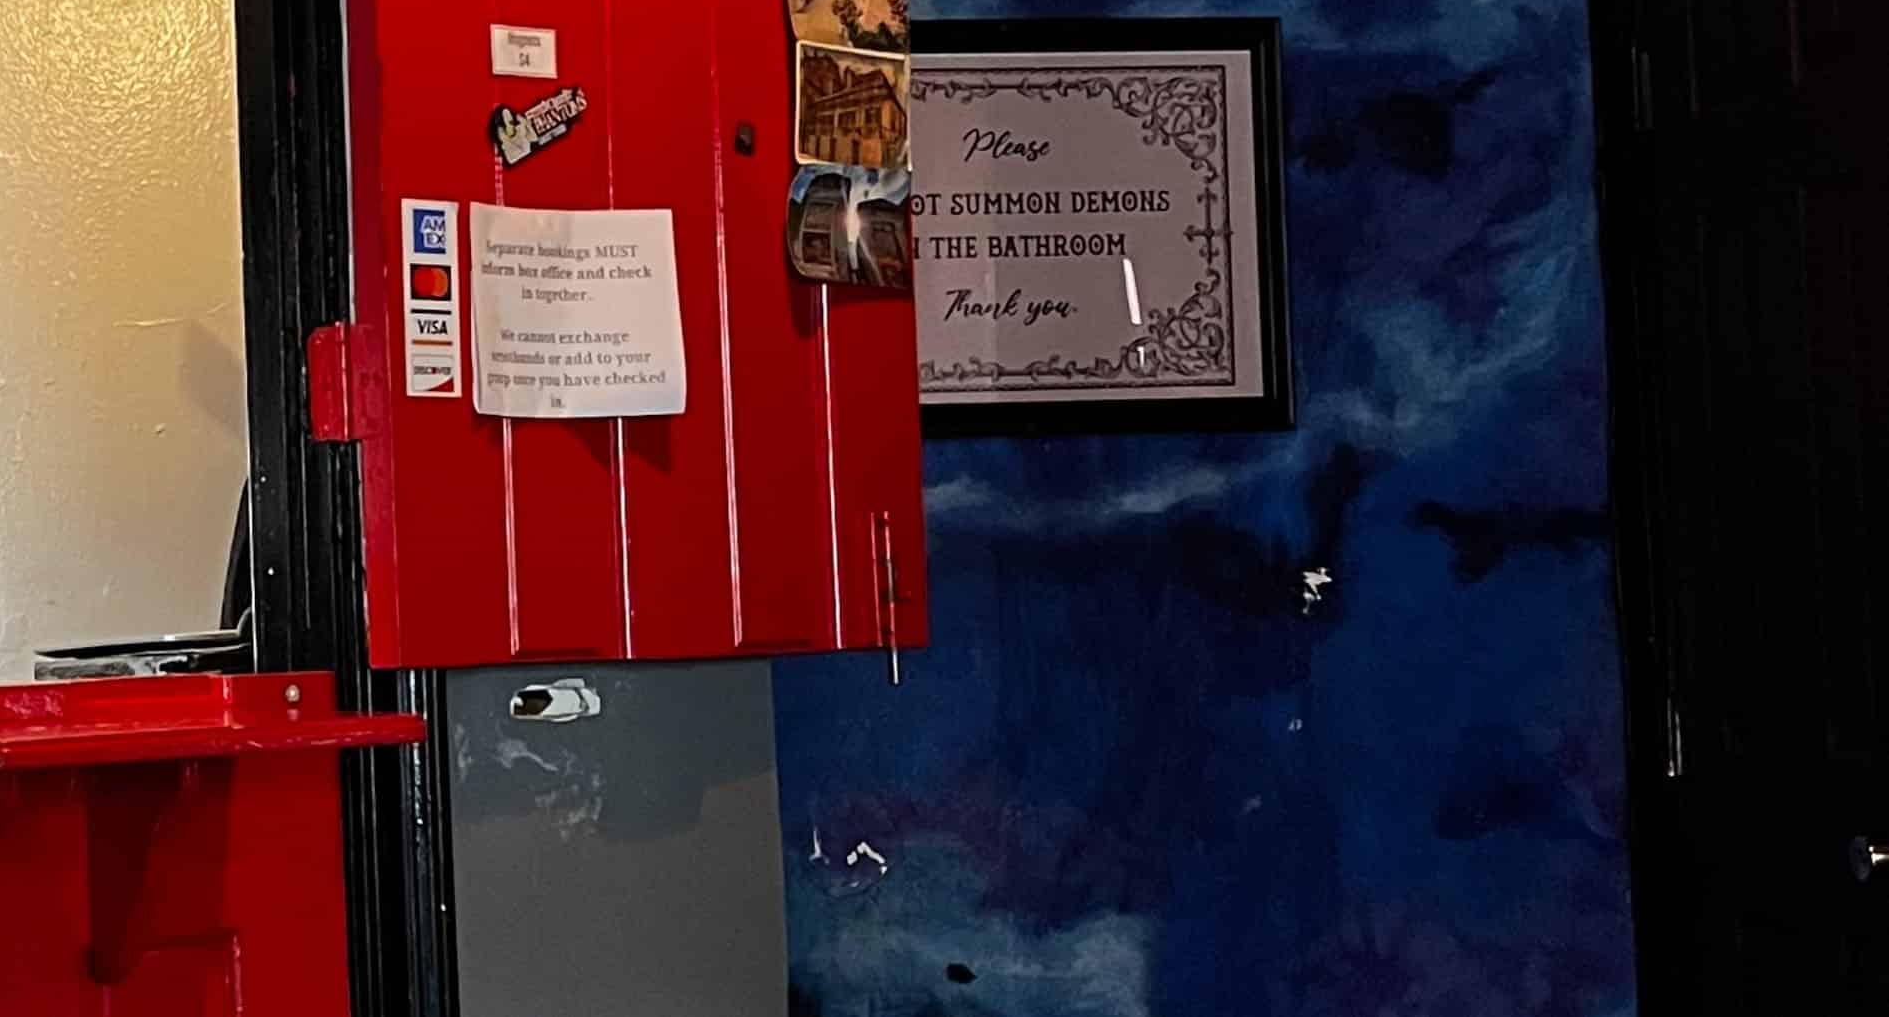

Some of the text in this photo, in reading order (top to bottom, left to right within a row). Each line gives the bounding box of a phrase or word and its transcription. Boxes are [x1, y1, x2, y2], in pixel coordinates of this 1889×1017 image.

[961, 127, 1051, 164] Please
[911, 189, 1171, 216] OT SUMMON DEMONS
[423, 216, 446, 232] AM
[595, 245, 639, 259] MUST
[929, 236, 977, 260] THE
[989, 233, 1127, 259] BATHROOM
[541, 265, 573, 279] office
[577, 265, 605, 279] and
[609, 265, 653, 279] check
[943, 288, 1019, 321] Thank
[417, 319, 449, 335] VISA
[559, 330, 631, 346] exchange
[548, 355, 561, 365] or
[564, 350, 593, 365] add
[597, 351, 611, 364] to
[615, 353, 651, 367] your
[563, 372, 601, 387] have
[605, 369, 666, 385] checked
